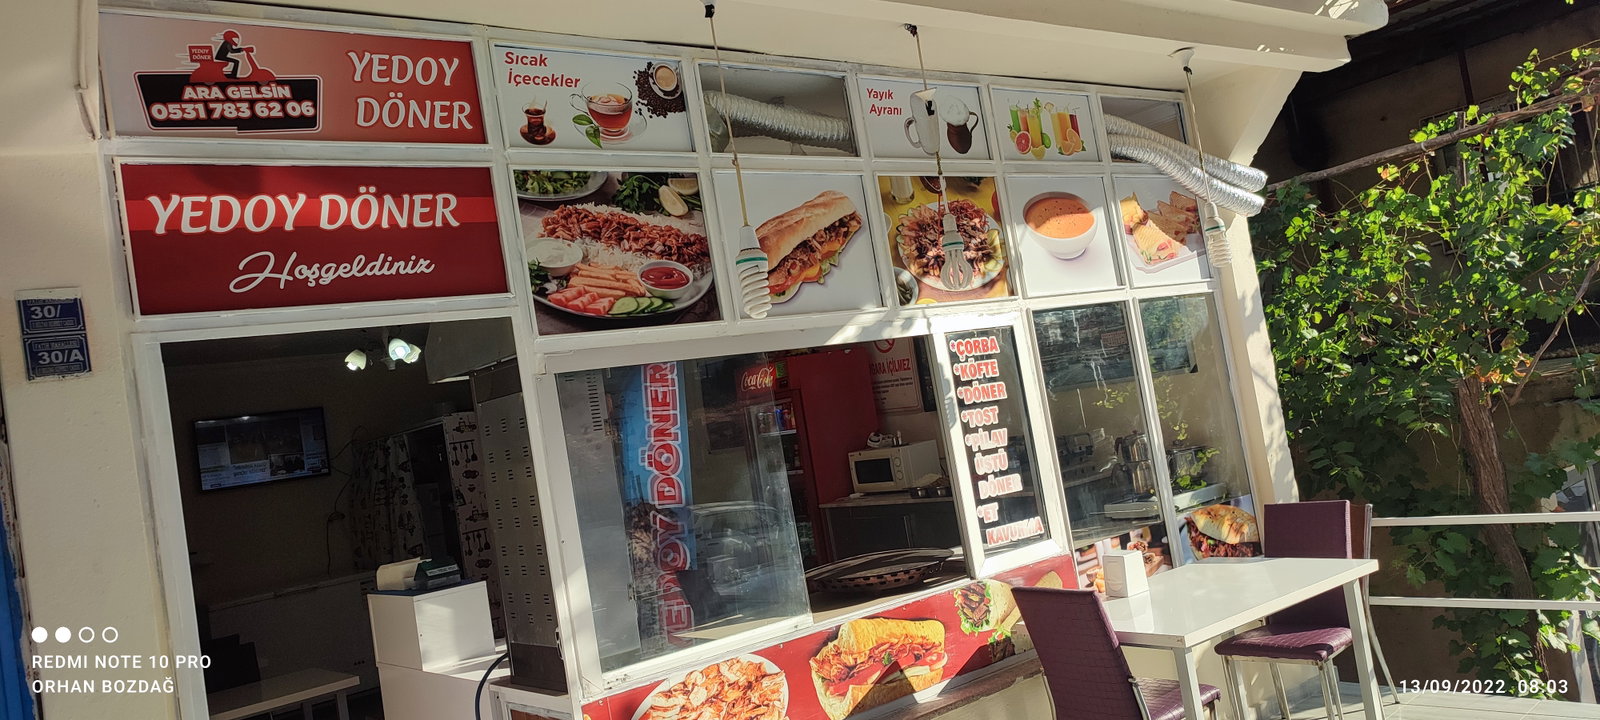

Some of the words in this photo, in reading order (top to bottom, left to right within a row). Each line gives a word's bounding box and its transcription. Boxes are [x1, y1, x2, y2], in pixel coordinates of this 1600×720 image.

[505, 51, 548, 67] Sıcak
[347, 52, 459, 86] YEDOY
[508, 68, 580, 87] İçecekler
[183, 85, 225, 99] ARA
[227, 83, 291, 99] GELSİN
[866, 88, 893, 101] Yayık
[151, 103, 206, 120] 0531
[208, 102, 250, 118] 783
[255, 102, 283, 117] 62
[286, 101, 315, 117] 06
[357, 92, 473, 129] DÖNER
[869, 104, 902, 116] Ayranı
[148, 193, 306, 234] YEDOY
[319, 186, 460, 230] DÖNER
[229, 251, 435, 293] Hoşgeldiniz
[37, 349, 84, 364] 30/A
[639, 362, 686, 508] DÖNER
[974, 448, 1008, 475] ÜSTÜ
